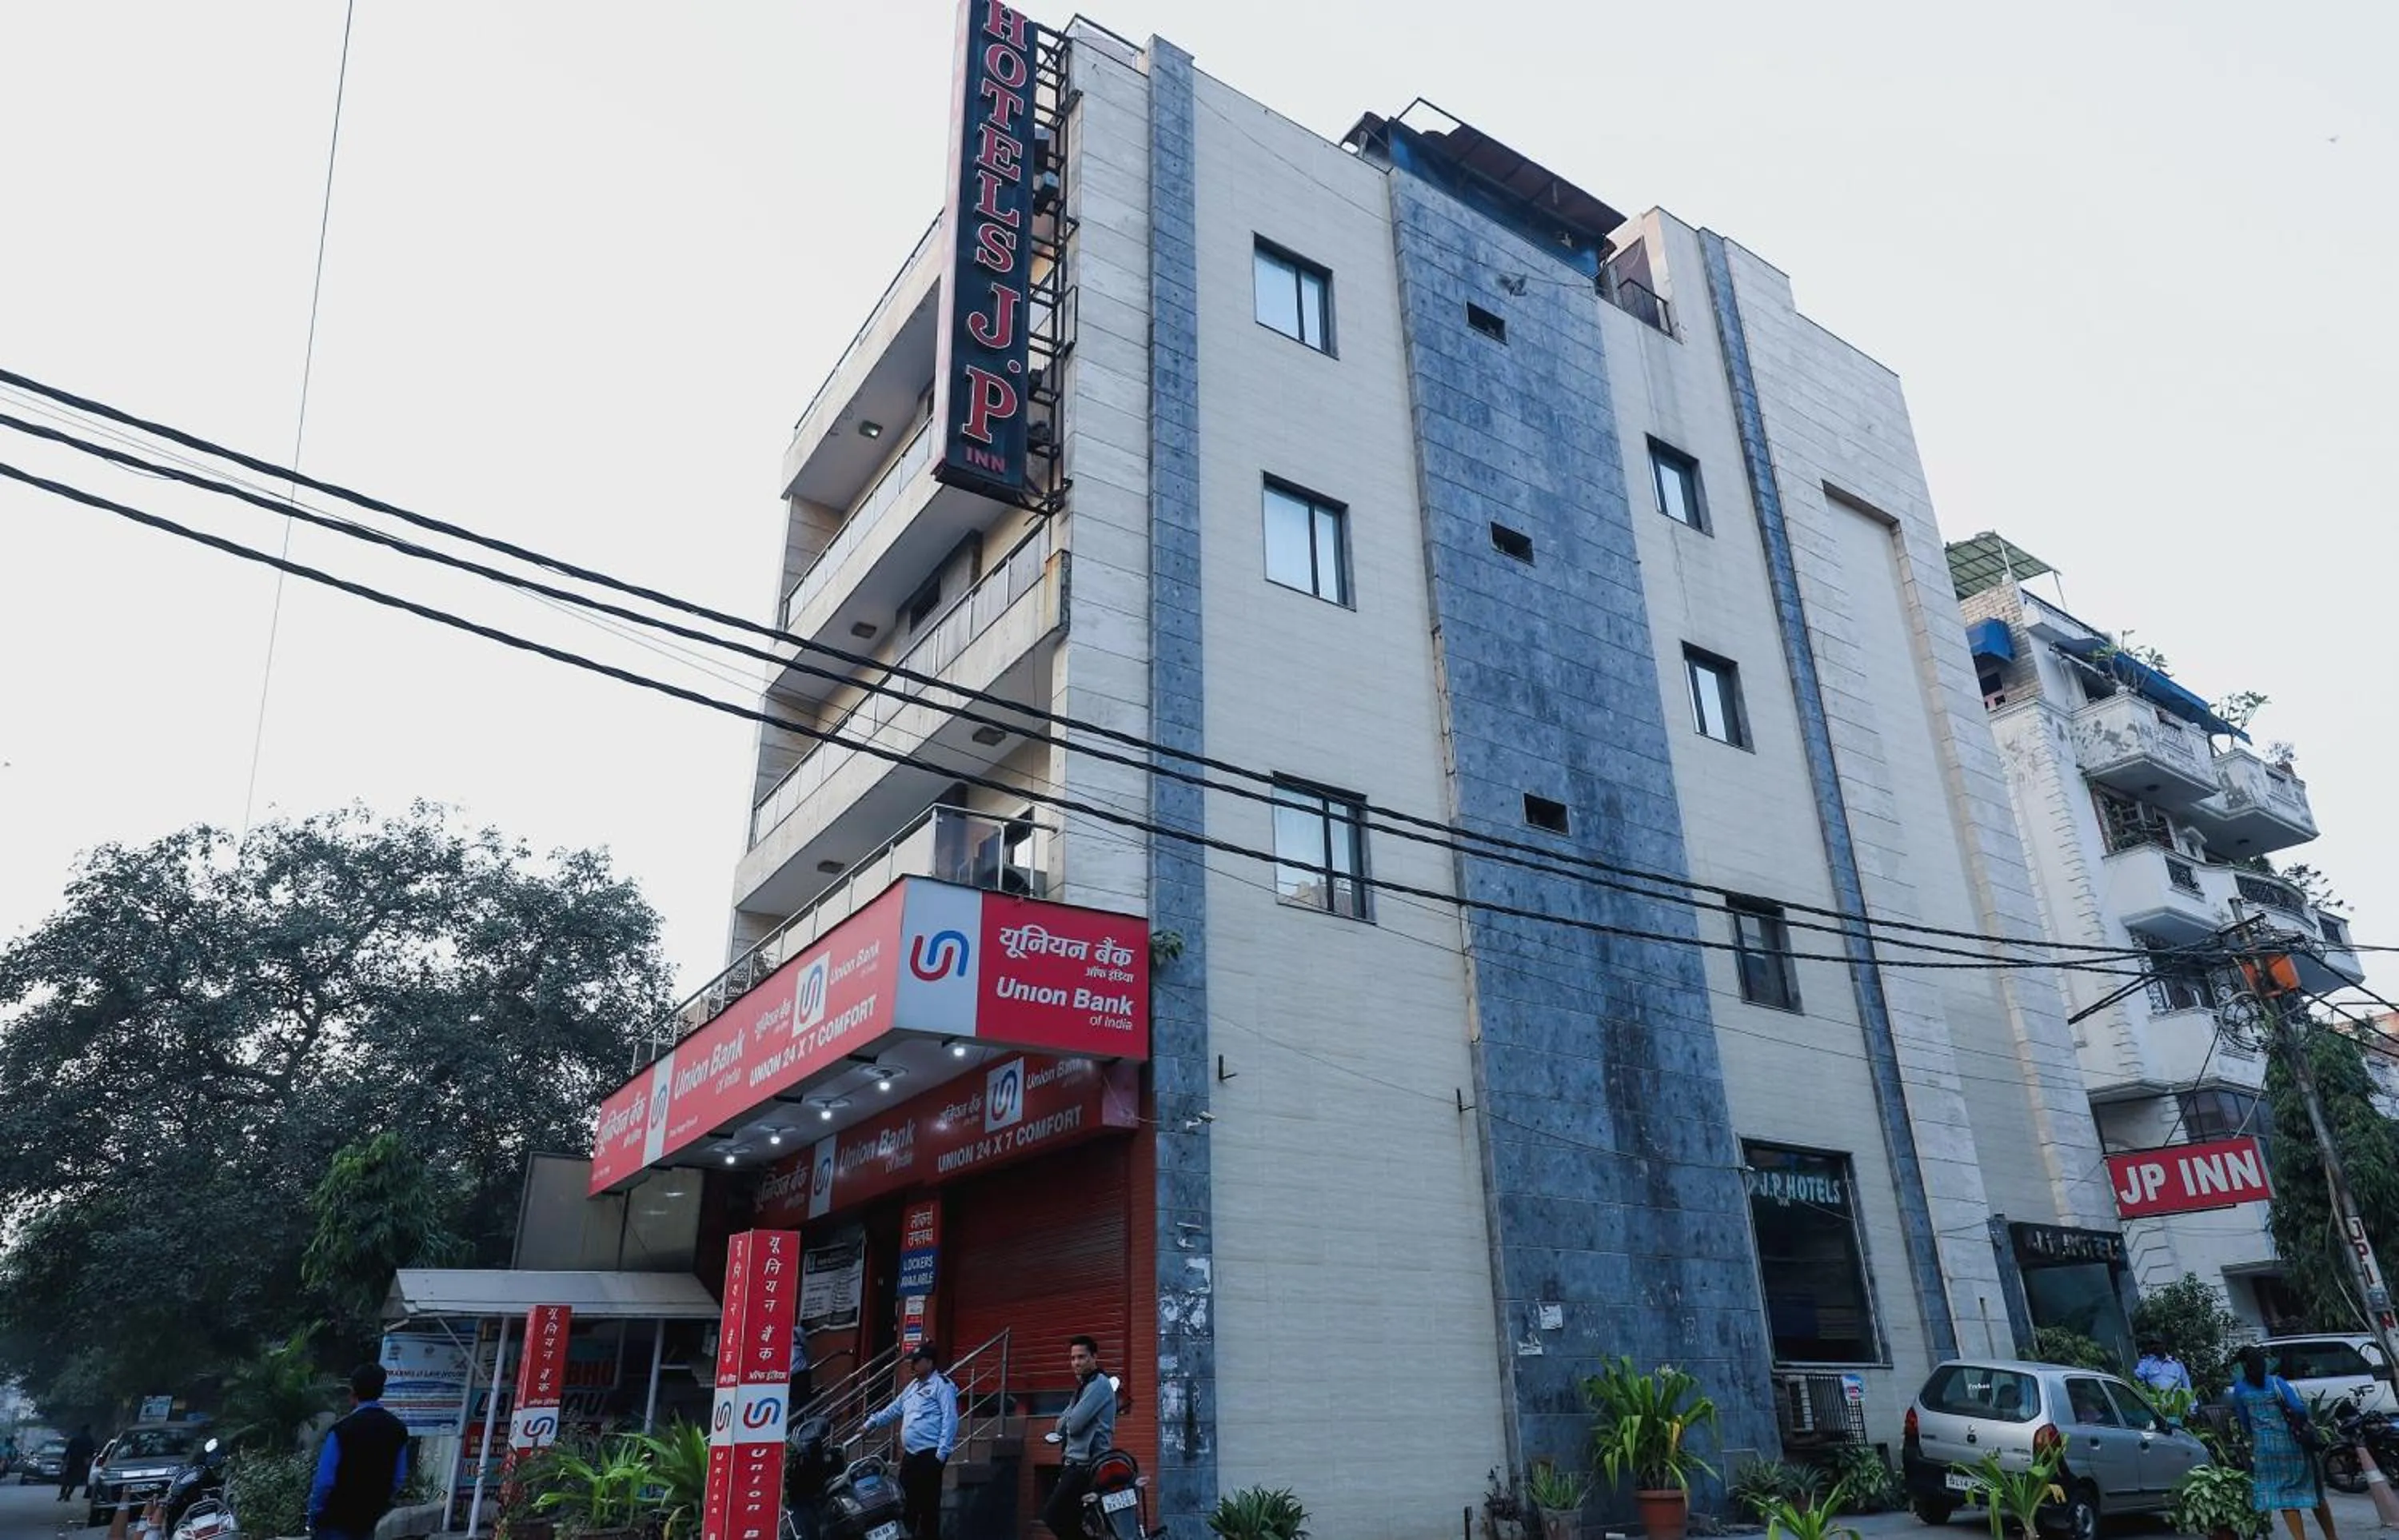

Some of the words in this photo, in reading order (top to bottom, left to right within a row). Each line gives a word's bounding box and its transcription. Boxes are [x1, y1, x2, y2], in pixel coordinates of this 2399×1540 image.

[974, 0, 1029, 275] HOTELS
[966, 445, 1007, 474] INN
[1000, 924, 1091, 959] यूनियन
[1094, 936, 1136, 967] बैंक
[996, 976, 1067, 1007] Union
[1073, 987, 1134, 1016] Bank
[750, 1052, 781, 1087] UNION
[783, 1043, 795, 1067] 24
[798, 1039, 807, 1060] X
[817, 994, 878, 1047] COMFORT
[1089, 1015, 1103, 1027] of
[1104, 1016, 1132, 1031] India
[674, 1059, 709, 1100] Union
[709, 1027, 745, 1078] Bank
[1026, 1067, 1055, 1089] Union
[838, 1139, 876, 1178] Union
[878, 1118, 916, 1156] Bank
[938, 1145, 974, 1173] UNION
[976, 1139, 991, 1160] 24
[994, 1135, 1002, 1154] X
[1006, 1131, 1014, 1150] 7
[1016, 1105, 1082, 1147] COMFORT
[1786, 1173, 1841, 1203] HOTELS
[2120, 1163, 2166, 1205] JP
[2178, 1150, 2262, 1197] INN
[764, 1236, 782, 1314] यूनियन
[903, 1255, 934, 1271] LOCKERS
[759, 1325, 776, 1362] बैंक
[746, 1448, 767, 1510] Union
